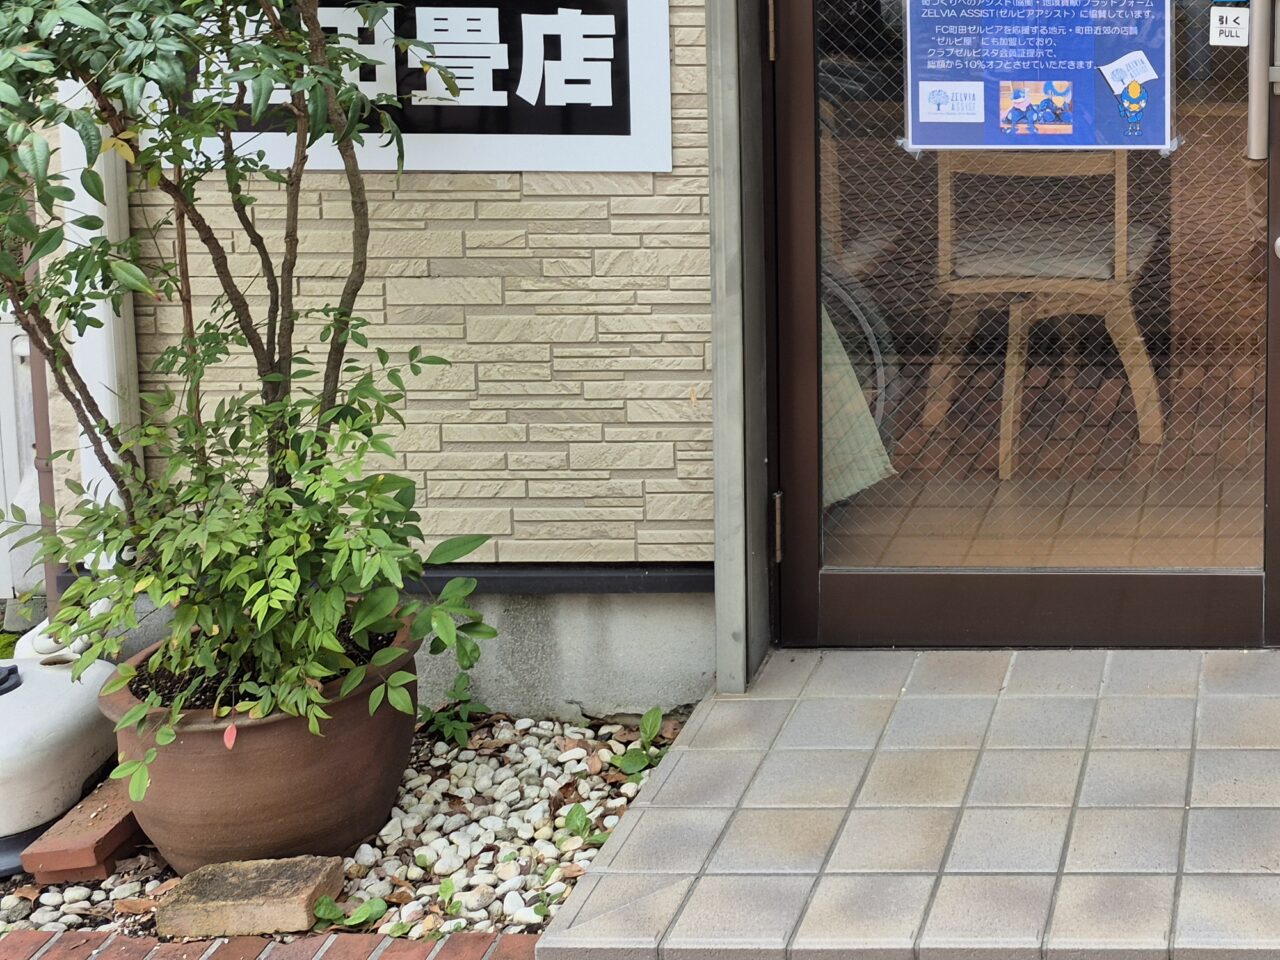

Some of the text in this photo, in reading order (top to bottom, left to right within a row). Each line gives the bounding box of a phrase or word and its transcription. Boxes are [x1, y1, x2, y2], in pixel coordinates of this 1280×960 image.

[921, 9, 957, 18] ZELVIA
[1218, 15, 1240, 26] 引く
[1219, 29, 1240, 38] PULL
